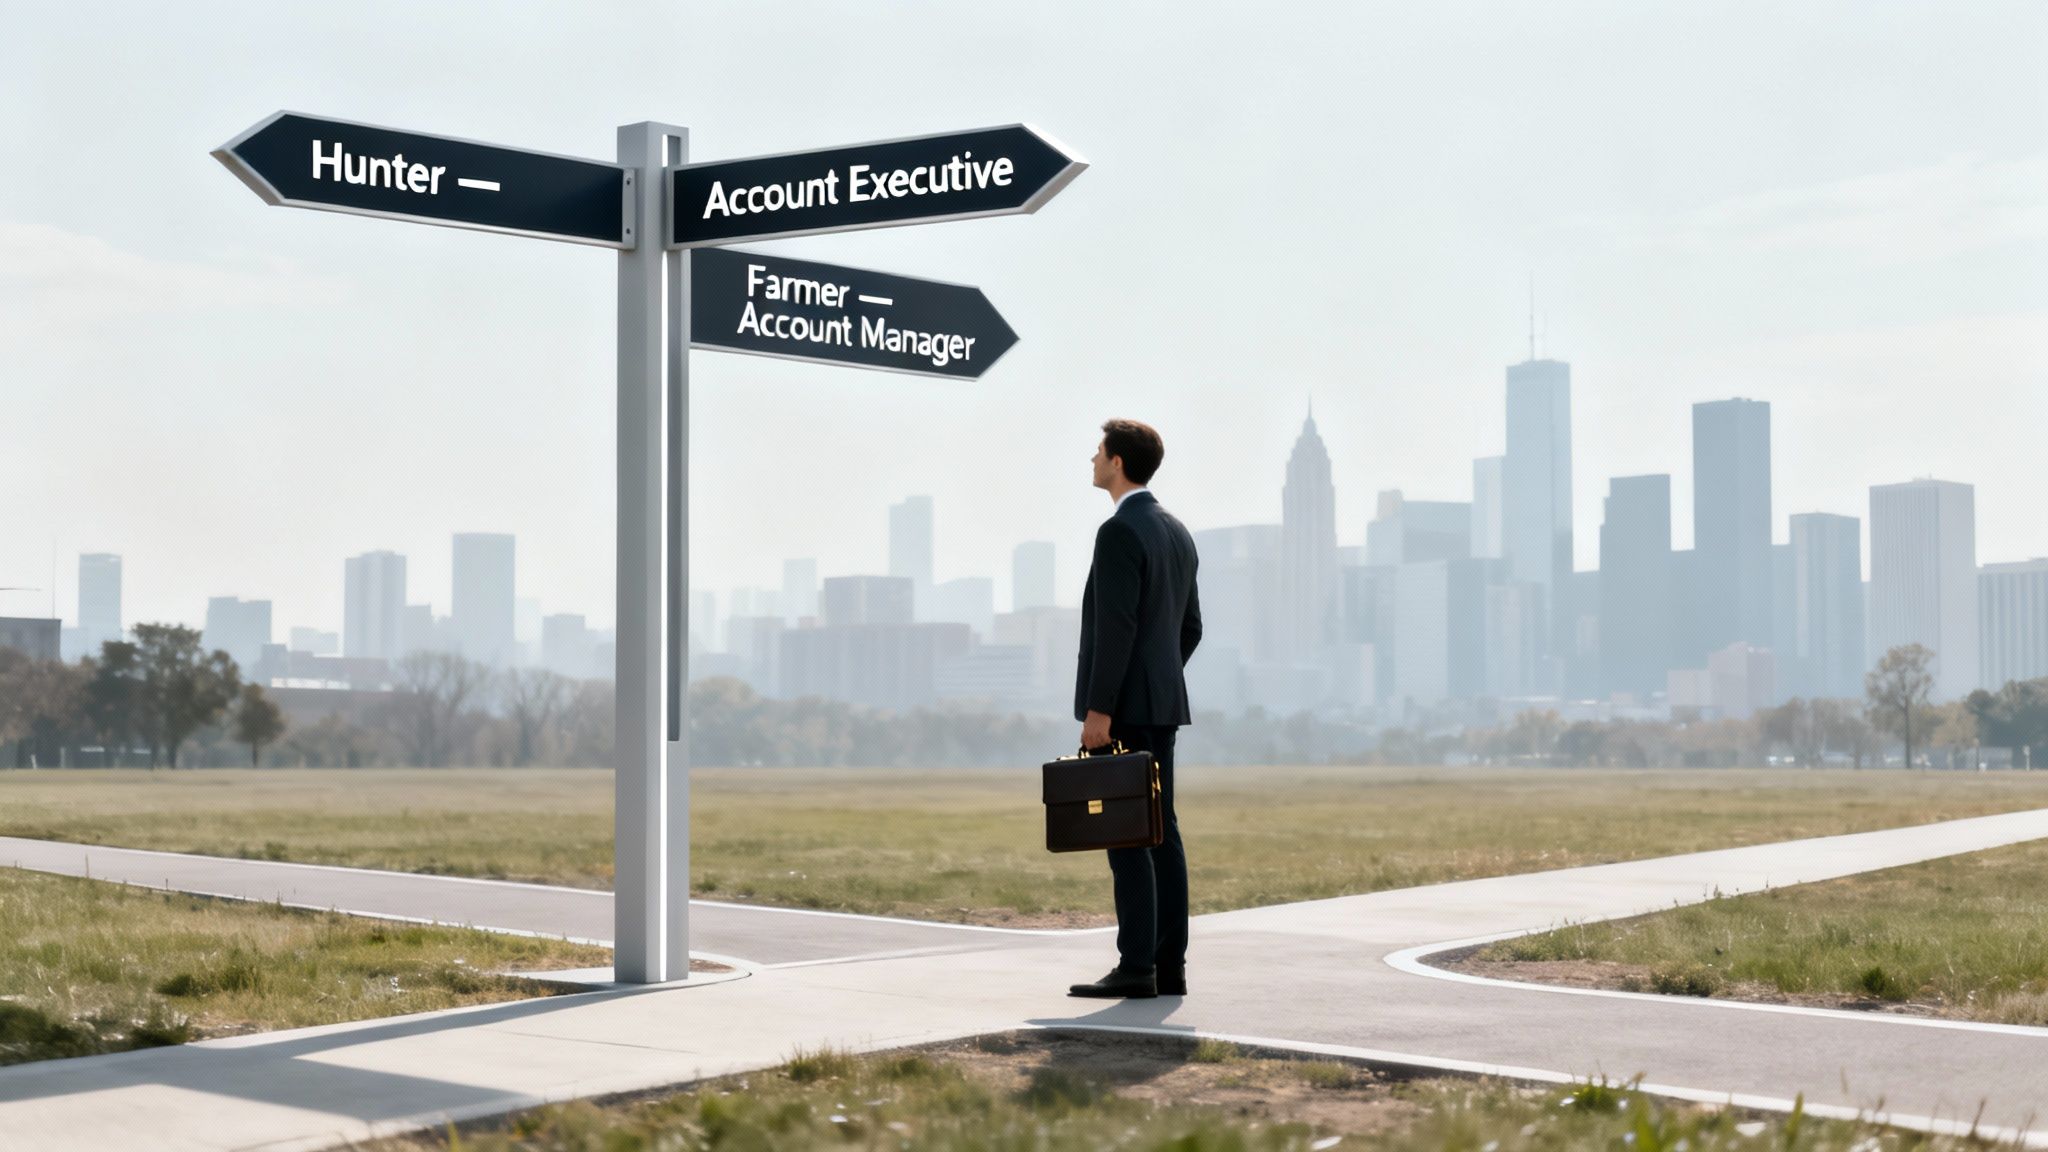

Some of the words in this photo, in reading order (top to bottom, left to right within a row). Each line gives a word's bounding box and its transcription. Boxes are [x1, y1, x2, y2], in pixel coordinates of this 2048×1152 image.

[311, 139, 447, 195] Hunter
[702, 168, 840, 220] Account
[848, 151, 1014, 203] Executive
[747, 263, 850, 308] Farmer
[736, 301, 852, 347] Account
[860, 315, 976, 367] Manager
